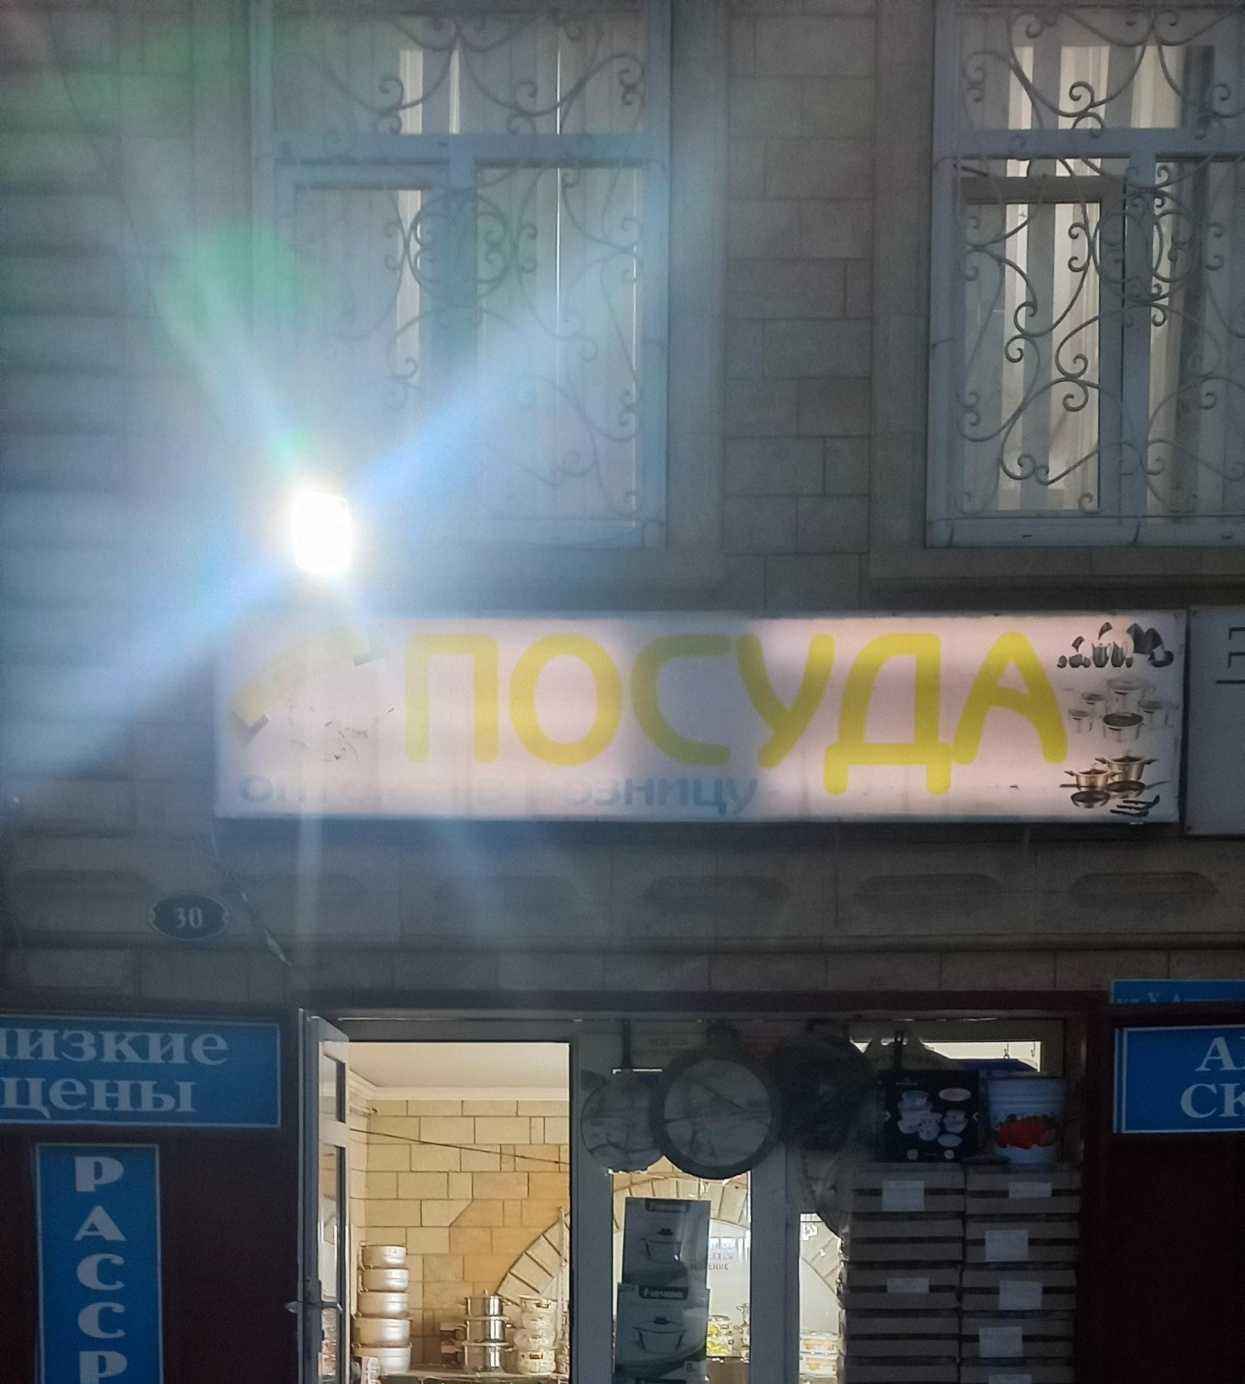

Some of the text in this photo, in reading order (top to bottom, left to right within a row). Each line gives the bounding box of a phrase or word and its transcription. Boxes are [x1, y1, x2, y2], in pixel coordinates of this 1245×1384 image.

[405, 632, 1067, 796] ПОСУДА
[176, 907, 203, 929] 30
[1195, 1036, 1245, 1071] А
[0, 1077, 197, 1119] цены
